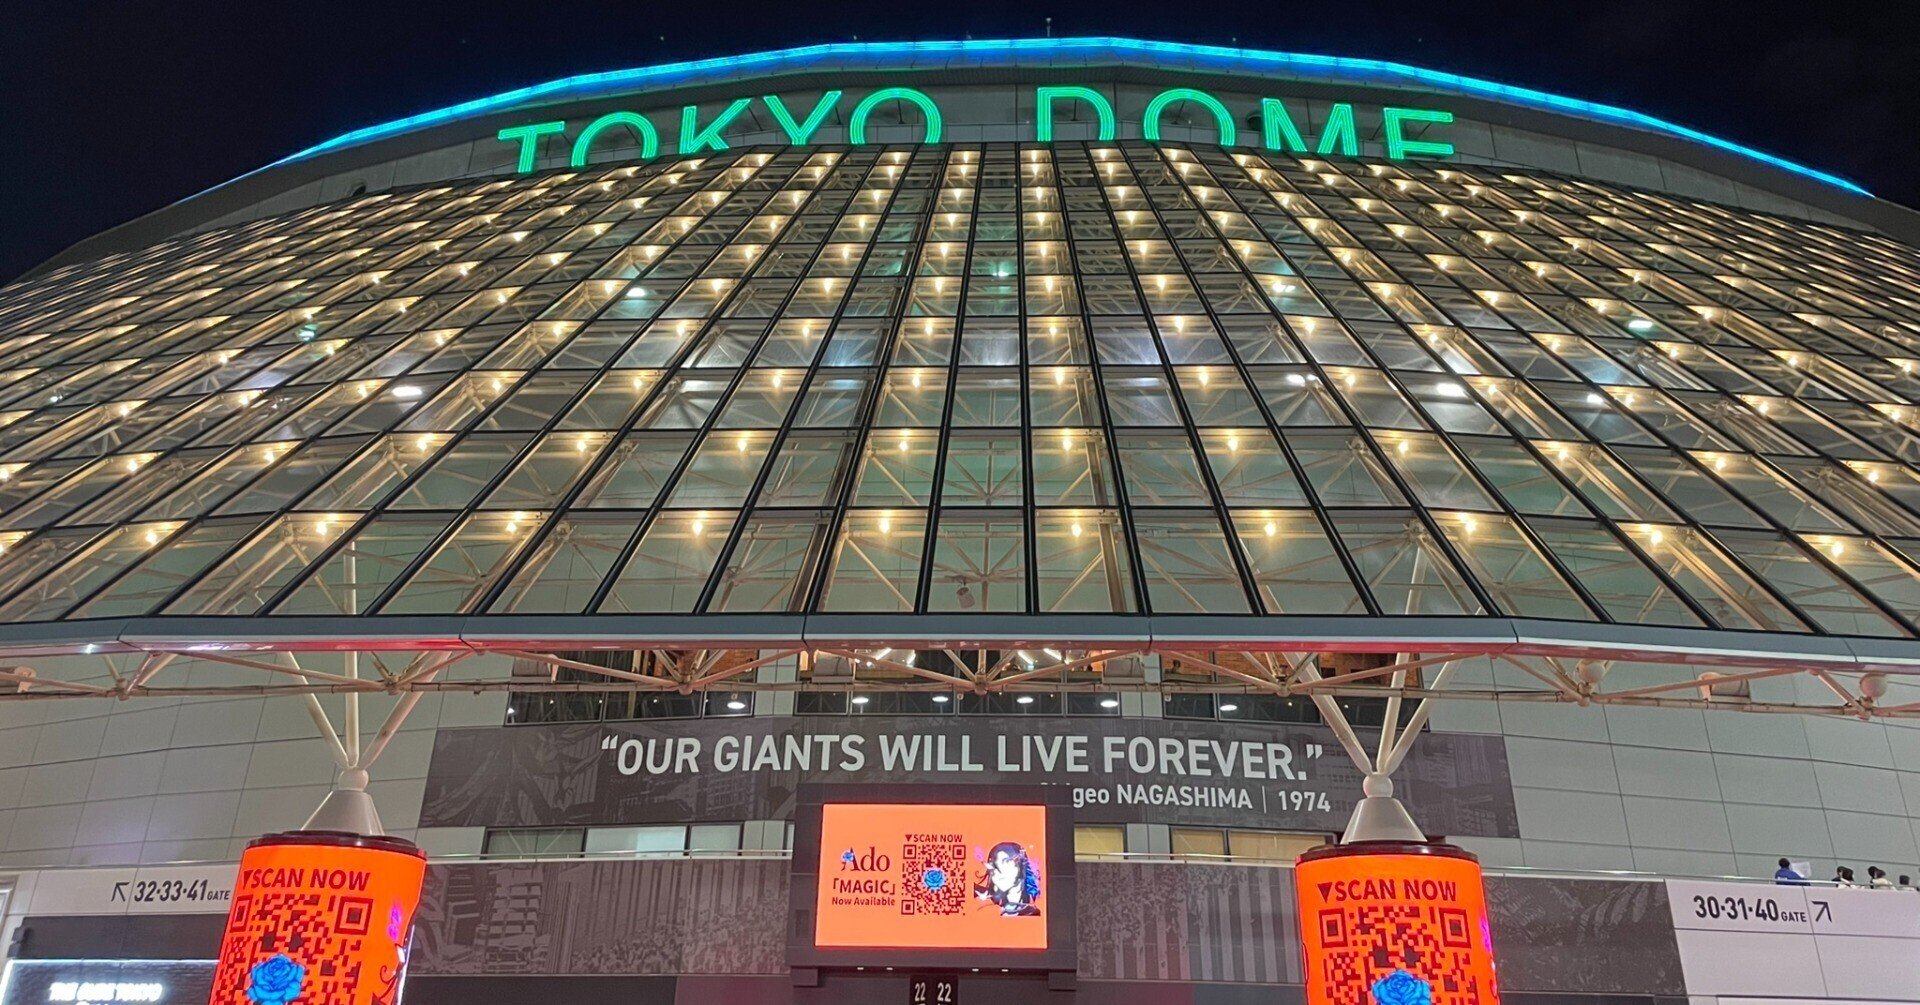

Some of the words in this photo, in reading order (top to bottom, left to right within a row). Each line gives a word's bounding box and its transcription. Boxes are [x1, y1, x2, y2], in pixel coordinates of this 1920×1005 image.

[498, 87, 942, 173] TOKYO
[1036, 87, 1454, 160] DOME
[713, 734, 866, 772] GIANTS
[878, 734, 984, 771] WILL
[997, 735, 1090, 773] LIVE
[1116, 784, 1253, 809] NAGASHIMA
[1278, 790, 1331, 813] 1974
[913, 833, 938, 843] SCAN
[940, 833, 963, 843] NOW
[841, 846, 891, 872] Ado
[251, 868, 303, 889] SCAN
[309, 870, 371, 892] NOW
[1334, 879, 1396, 901] SCAN
[1403, 880, 1457, 902] NOW
[207, 889, 231, 901] GATE
[832, 896, 851, 906] Now
[853, 896, 895, 906] Available
[1780, 911, 1807, 923] GATE
[914, 982, 926, 1002] 22
[937, 982, 952, 1002] 22
